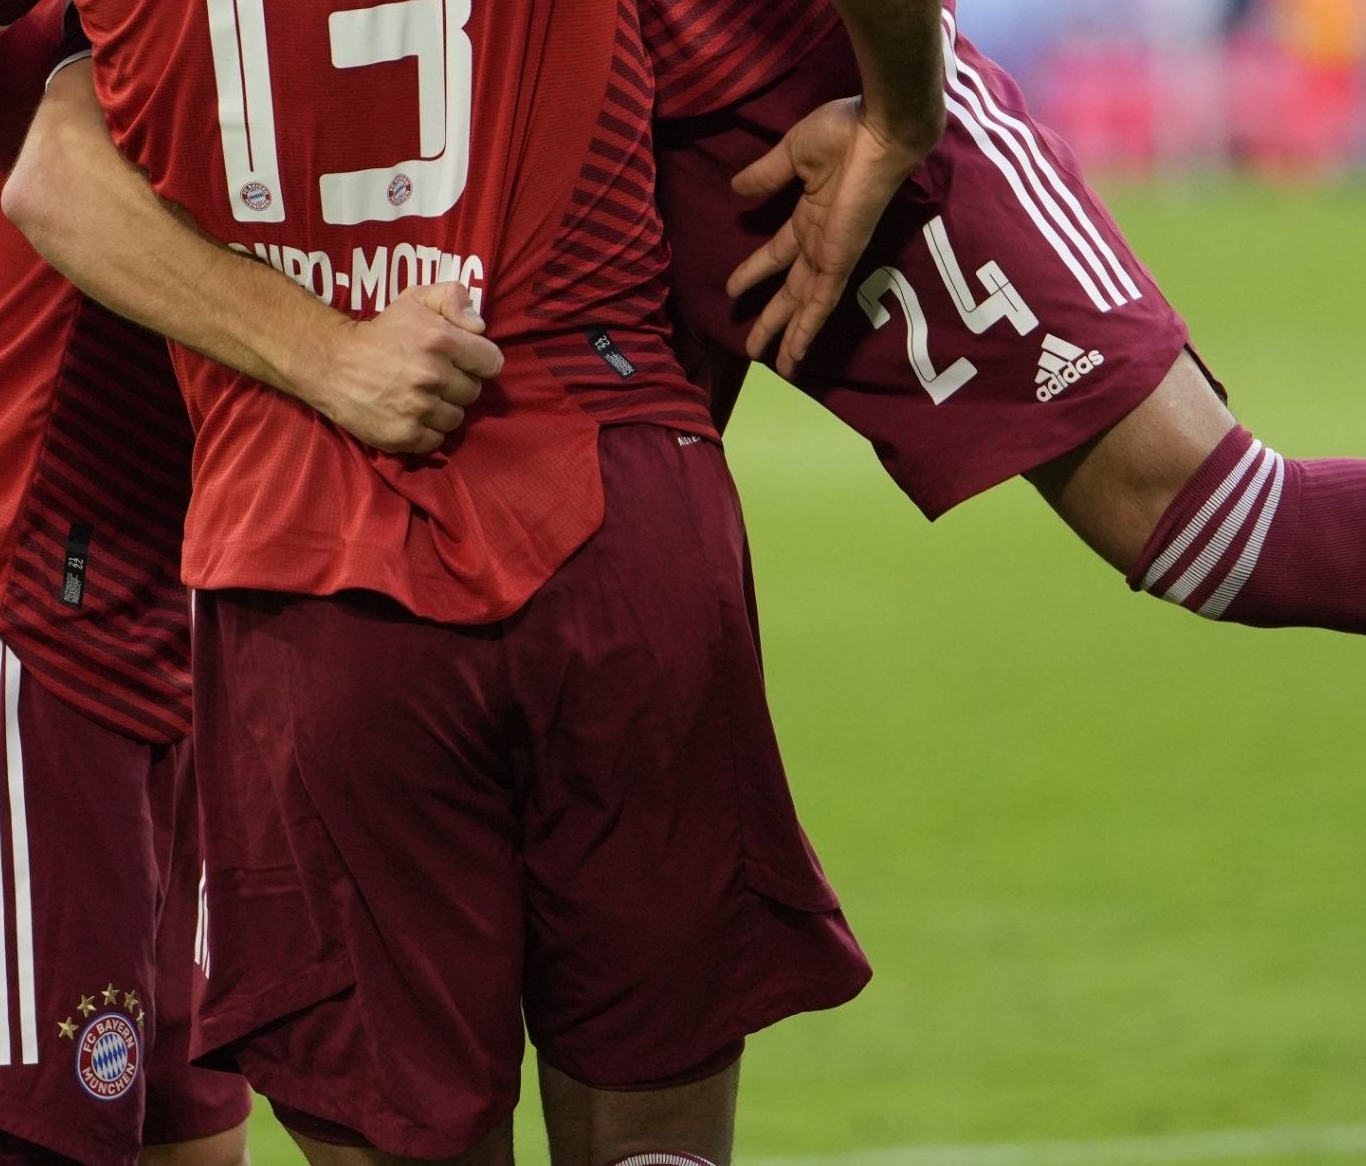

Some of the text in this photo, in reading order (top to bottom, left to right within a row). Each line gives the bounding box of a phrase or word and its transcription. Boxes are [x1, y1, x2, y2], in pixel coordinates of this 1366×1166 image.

[856, 215, 1039, 405] 24
[1036, 349, 1105, 402] adidas
[83, 1019, 135, 1052] FC BAYERN
